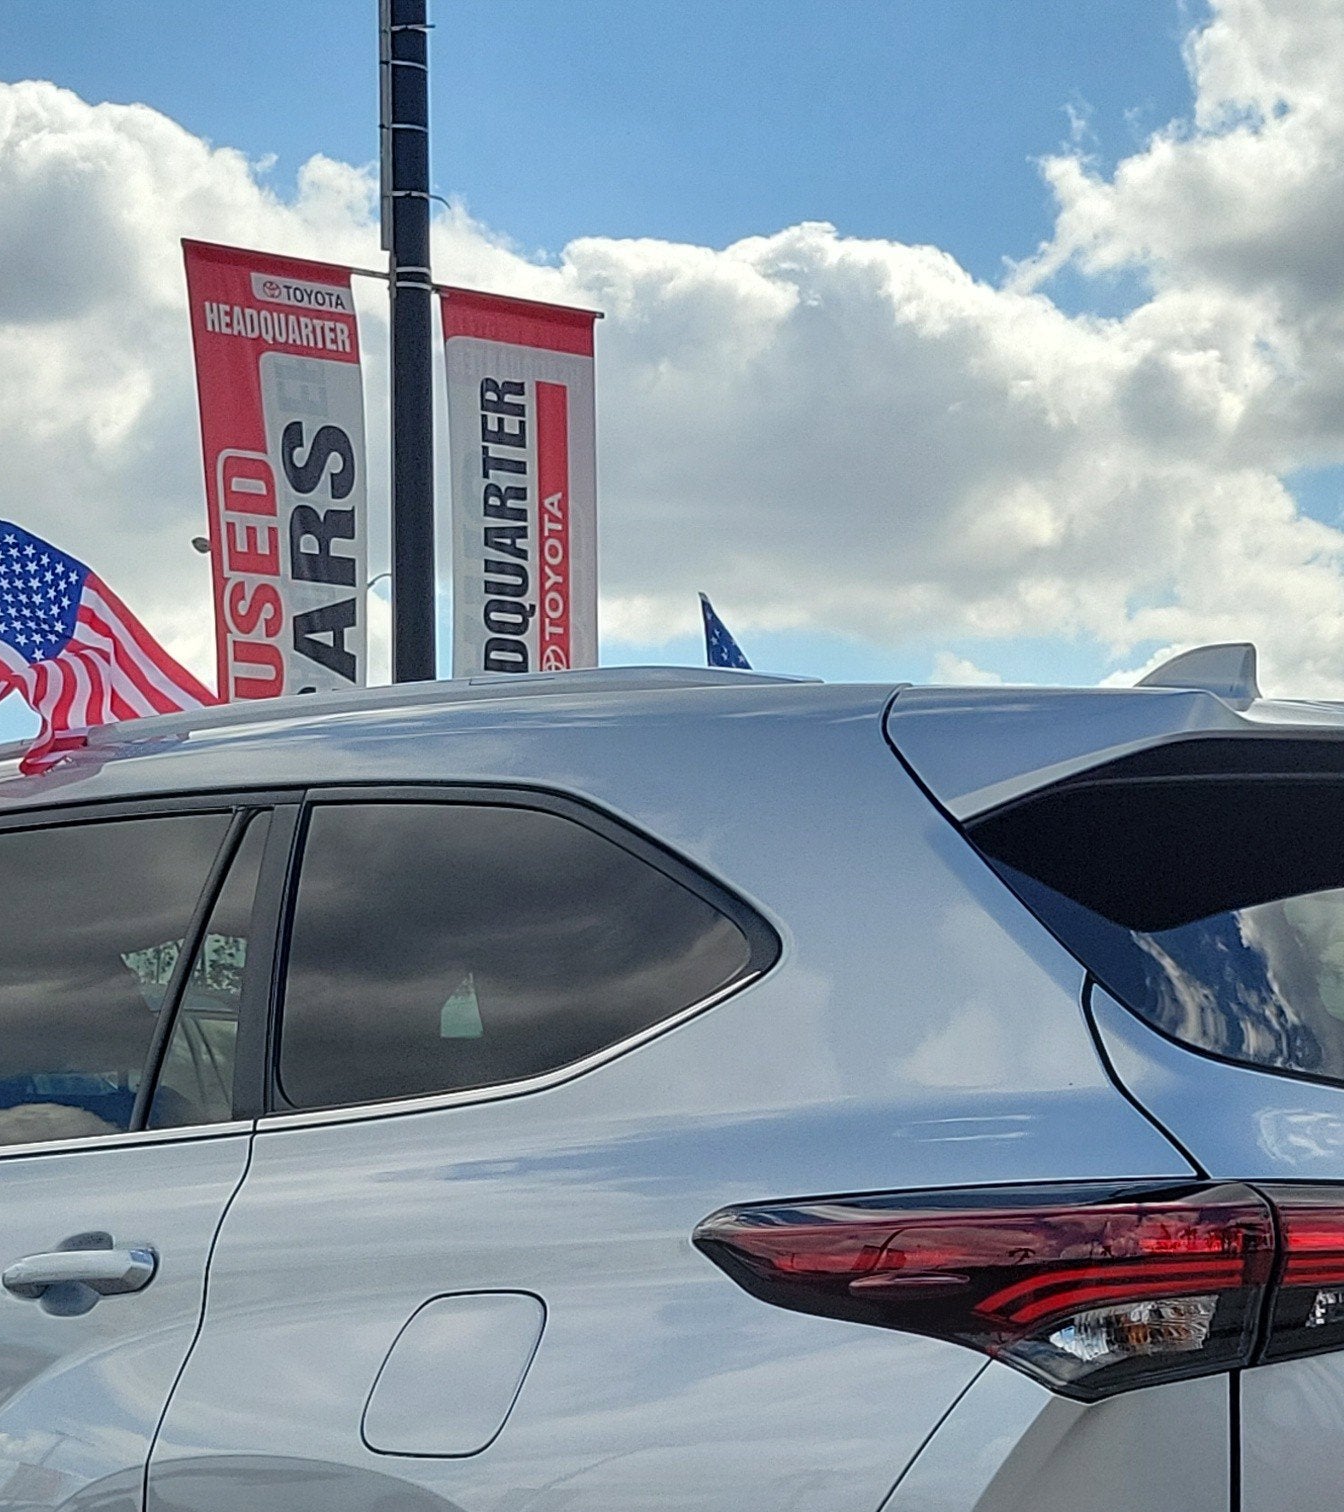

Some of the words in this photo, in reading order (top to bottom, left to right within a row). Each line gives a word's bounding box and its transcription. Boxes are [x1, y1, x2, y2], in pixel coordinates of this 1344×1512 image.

[204, 301, 352, 353] HEADQUARTER
[282, 284, 346, 310] TOYOTA
[219, 454, 286, 701] USED
[280, 420, 356, 695] ARS
[542, 491, 564, 642] TOYOTA
